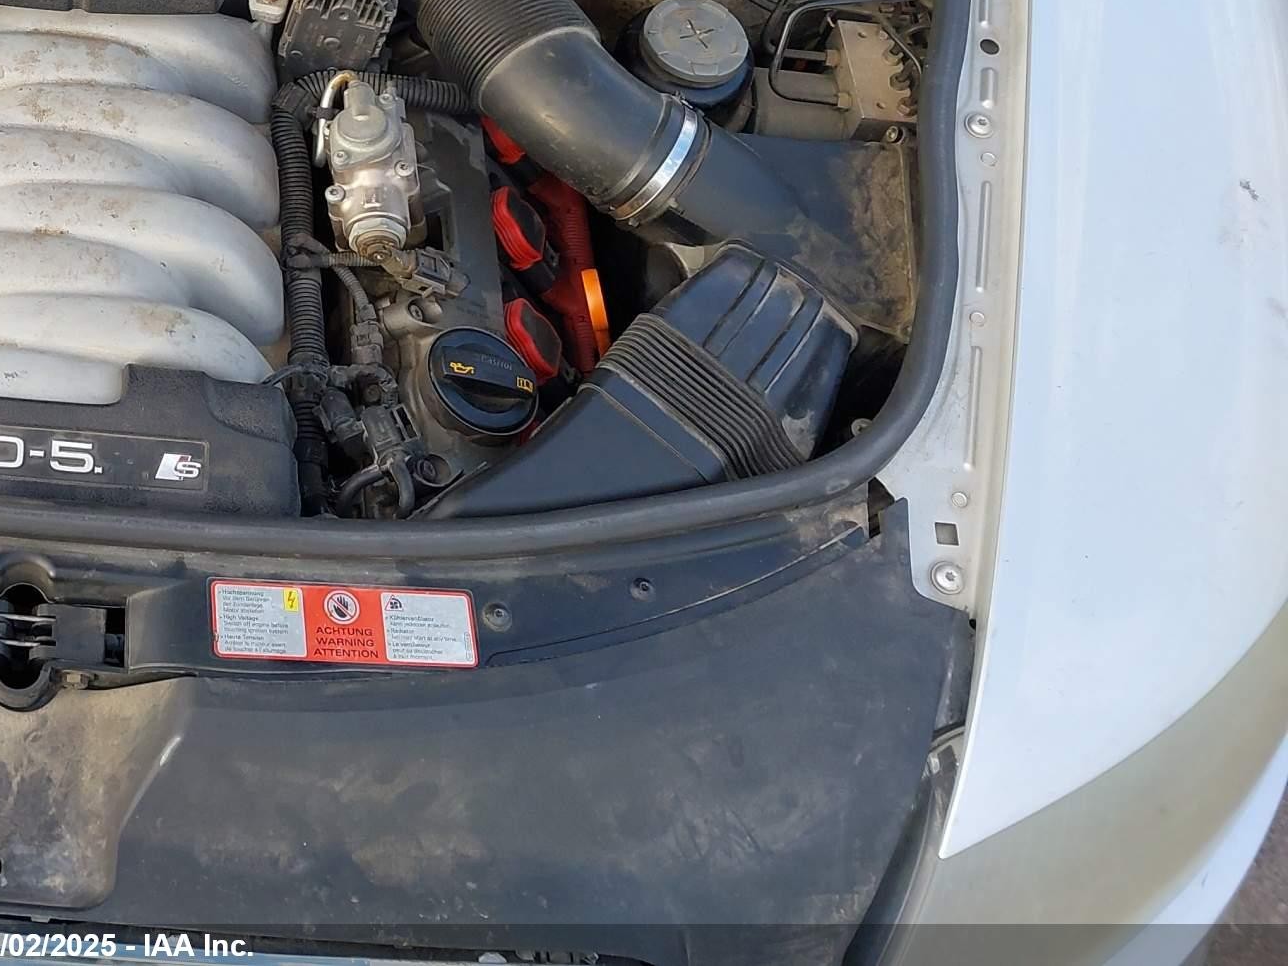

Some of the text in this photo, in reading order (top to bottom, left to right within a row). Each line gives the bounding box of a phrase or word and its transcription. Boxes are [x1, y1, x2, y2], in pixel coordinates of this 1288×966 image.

[316, 627, 372, 636] ACHTUNG
[316, 638, 374, 646] WARNING
[314, 648, 378, 658] ATTENTION
